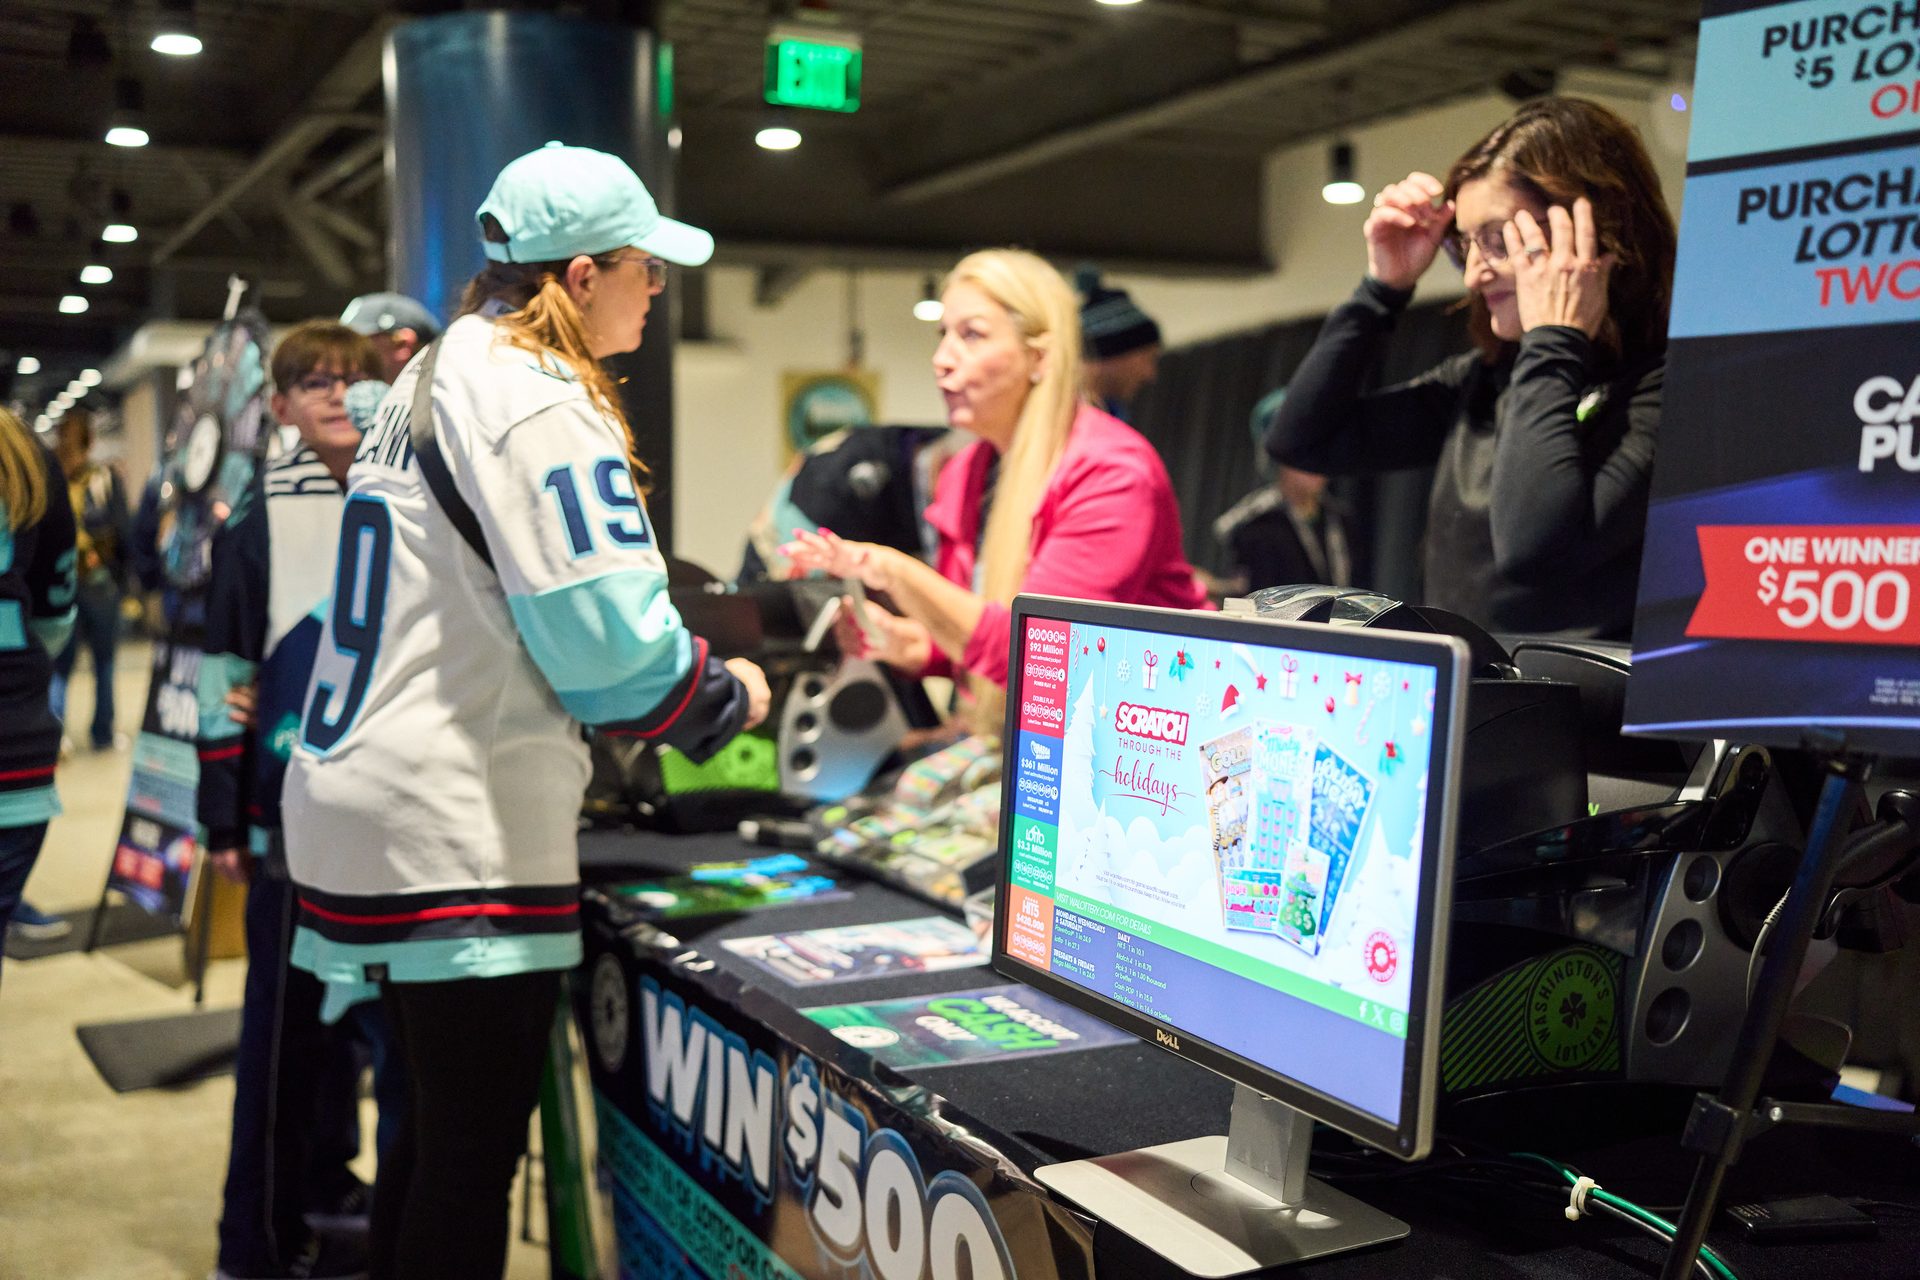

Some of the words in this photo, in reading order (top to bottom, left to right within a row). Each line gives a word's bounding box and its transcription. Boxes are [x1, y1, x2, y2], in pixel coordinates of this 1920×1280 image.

[1794, 56, 1835, 89] $5
[1852, 38, 1920, 82] LO
[1737, 167, 1920, 225] PURCH
[1794, 213, 1920, 264] LOTT
[543, 455, 652, 560] 19
[1744, 536, 1807, 564] ONE
[1757, 565, 1910, 631] $500
[1030, 641, 1042, 653] $92
[1042, 644, 1064, 656] Million
[1116, 703, 1188, 744] SCRATCH
[1022, 757, 1036, 770] $361
[1038, 762, 1058, 776] Million
[1119, 737, 1161, 757] THROUGH
[1166, 748, 1182, 761] THE
[1112, 755, 1182, 817] holidays
[1056, 891, 1068, 904] VISIT
[1116, 912, 1128, 928] FOR
[1129, 917, 1152, 936] DETAILS
[1116, 952, 1129, 962] Match
[1117, 932, 1131, 943] DAILY
[1114, 982, 1125, 992] Cash
[1114, 992, 1124, 1004] Daily
[1146, 975, 1166, 990] thousand
[1534, 960, 1611, 1045] WASHINGTON'S
[927, 998, 1062, 1051] CASH
[1156, 1028, 1180, 1050] DELL
[1555, 1015, 1608, 1061] LOTTERY
[640, 987, 775, 1190] WIN
[786, 1072, 1006, 1280] $500
